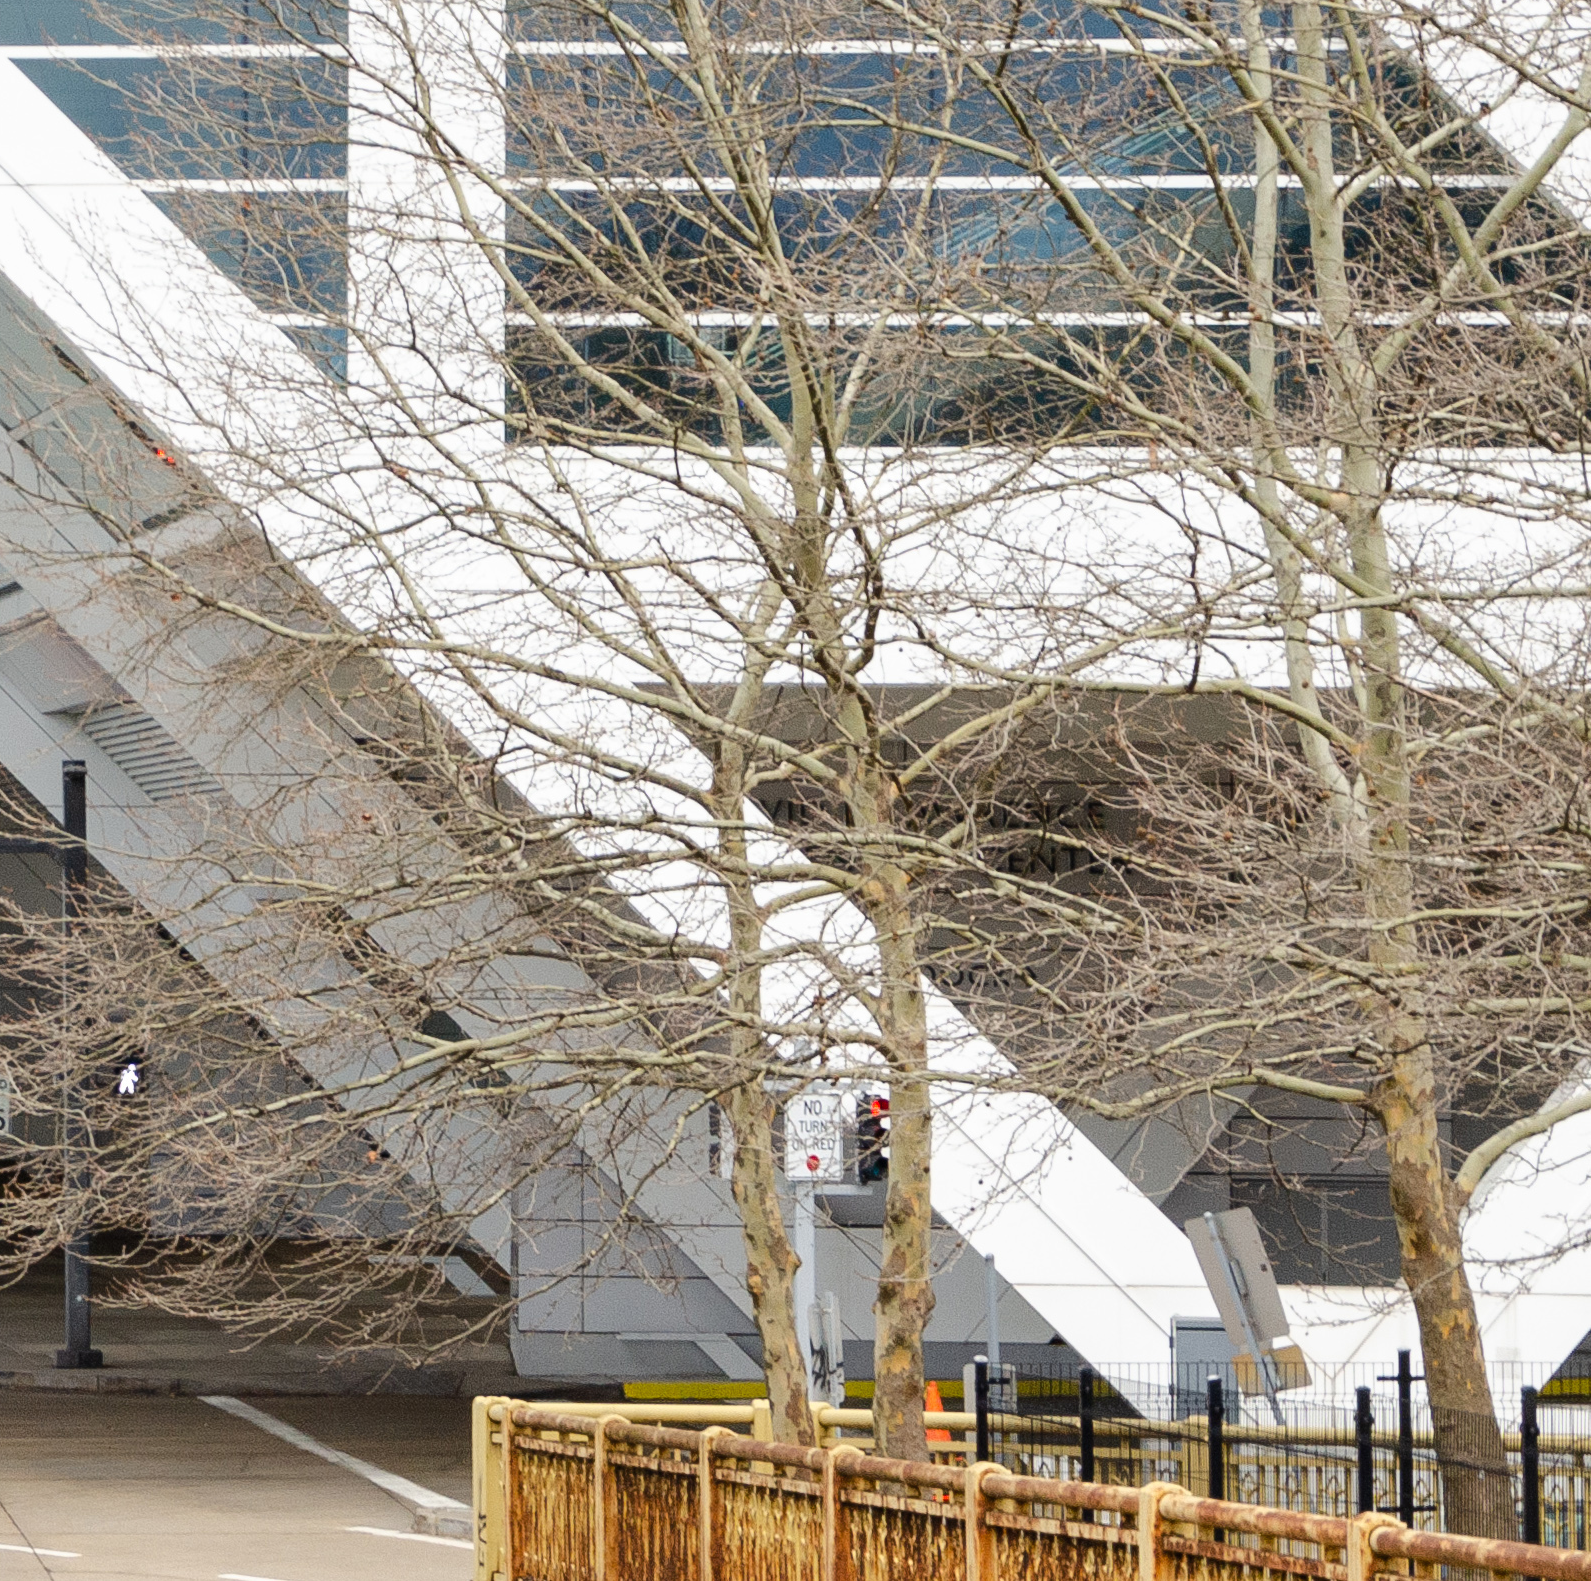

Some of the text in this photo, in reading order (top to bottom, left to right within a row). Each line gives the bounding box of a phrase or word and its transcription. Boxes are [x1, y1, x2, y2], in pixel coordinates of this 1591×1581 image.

[803, 1100, 823, 1115] NO
[799, 1120, 827, 1133] TURN
[813, 1138, 835, 1150] RED
